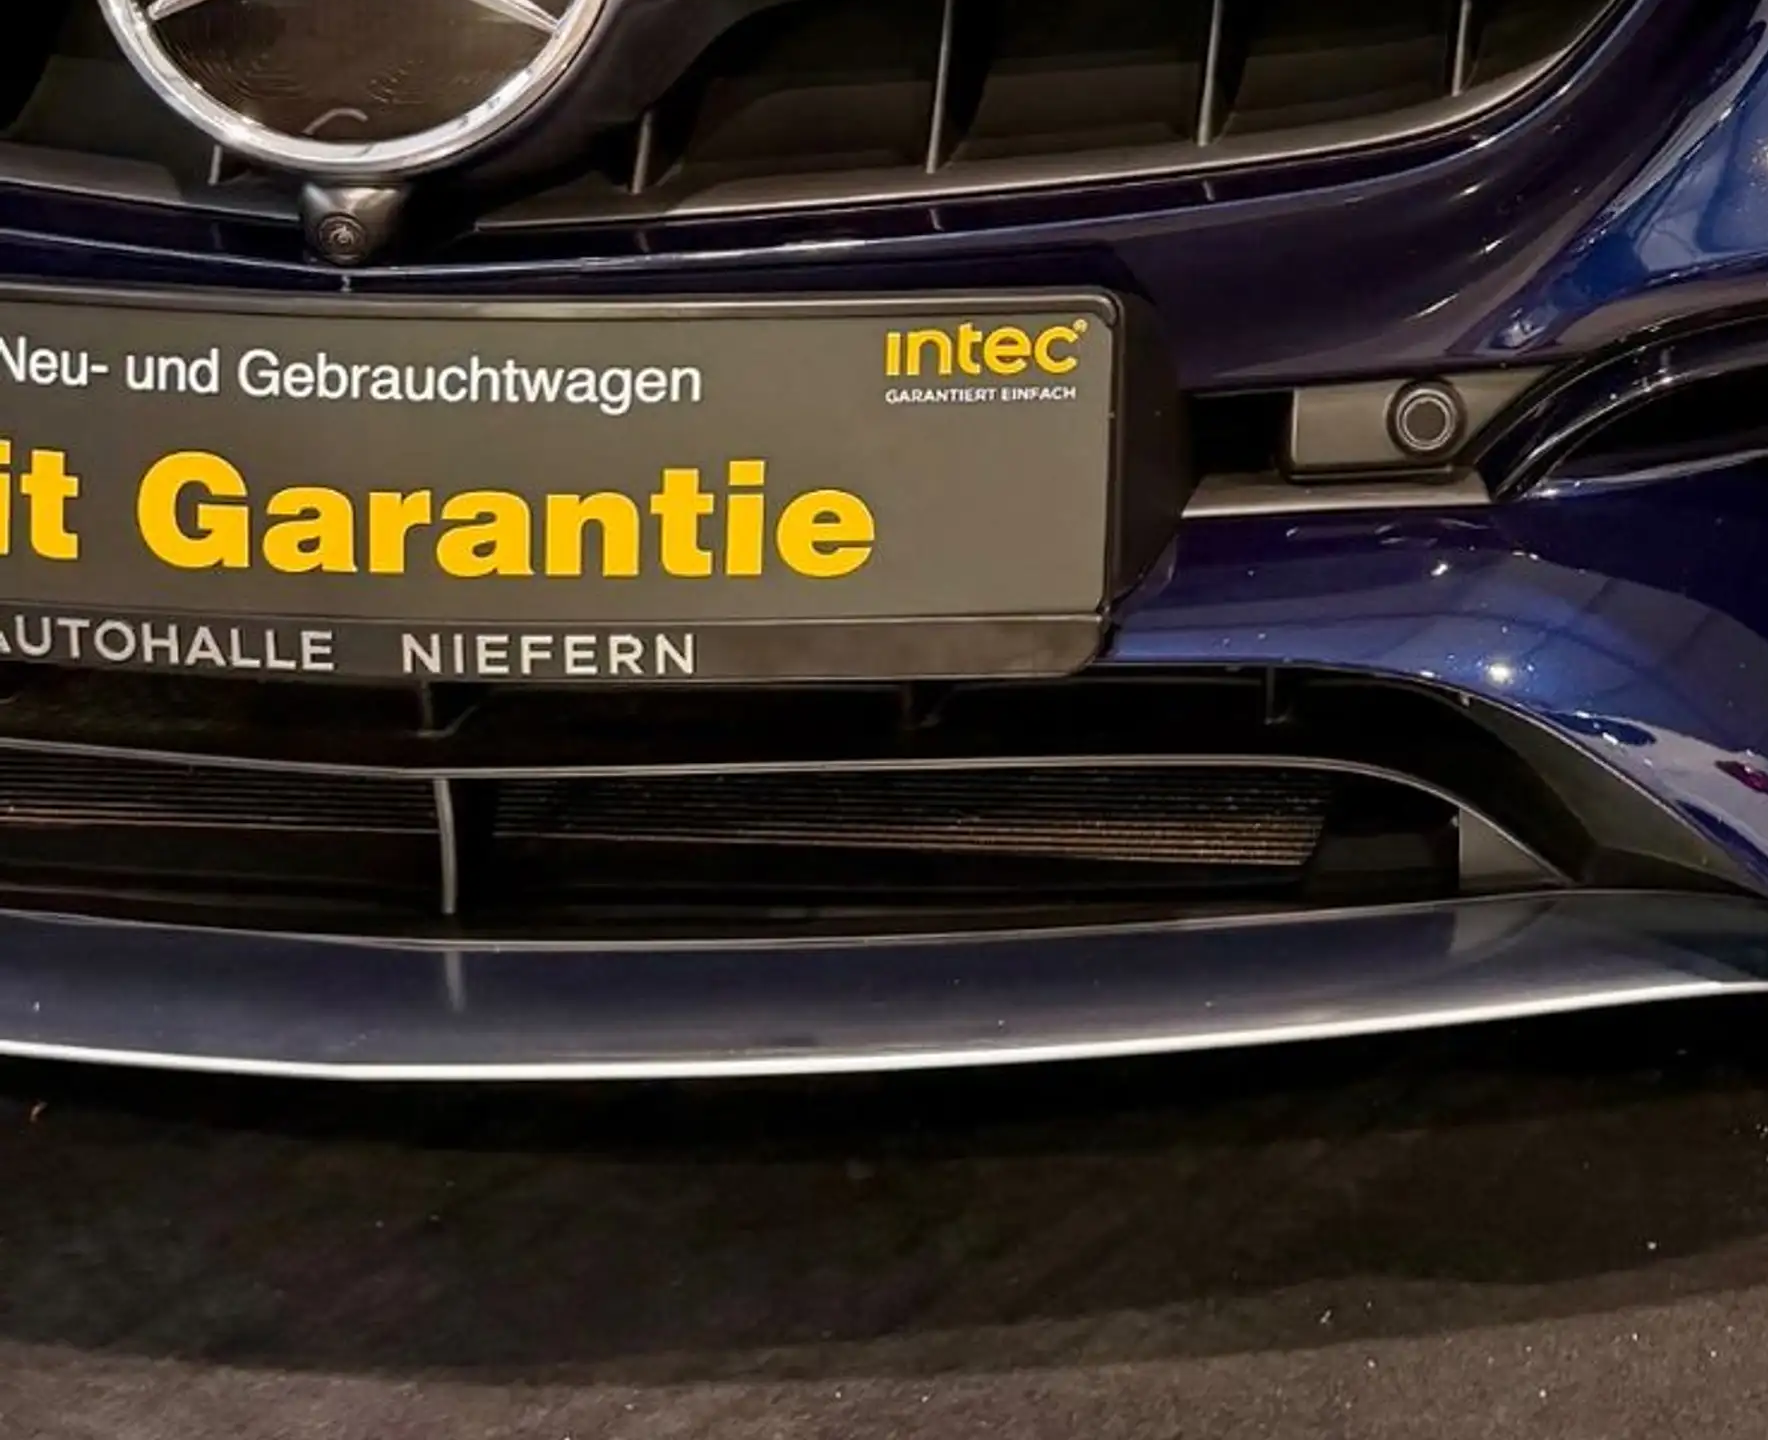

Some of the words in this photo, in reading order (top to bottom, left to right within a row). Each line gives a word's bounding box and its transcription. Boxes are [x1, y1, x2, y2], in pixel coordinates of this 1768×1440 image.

[0, 335, 109, 387] Neu-
[126, 348, 220, 394] und
[237, 348, 701, 415] Gebrauchtwagen
[885, 388, 996, 404] GARANTIERT
[1001, 386, 1077, 401] EINFACH
[137, 450, 875, 578] Garantie
[0, 614, 335, 671] UTOHALLE
[402, 632, 697, 675] NIEFERN
